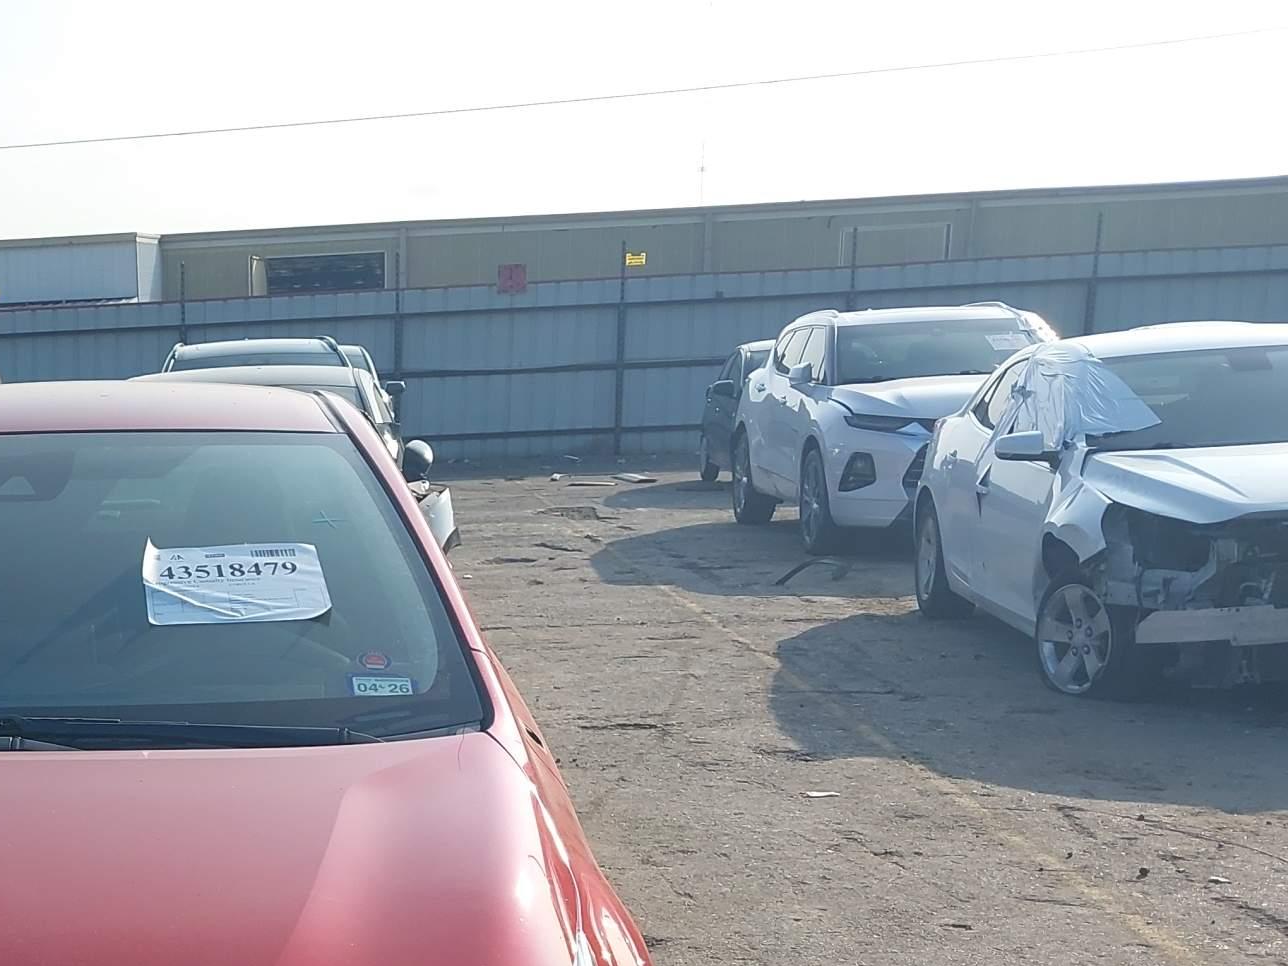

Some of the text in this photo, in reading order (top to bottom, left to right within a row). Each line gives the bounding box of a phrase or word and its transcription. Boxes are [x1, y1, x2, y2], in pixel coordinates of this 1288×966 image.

[160, 562, 297, 579] 43518479
[357, 682, 410, 694] 04 26
